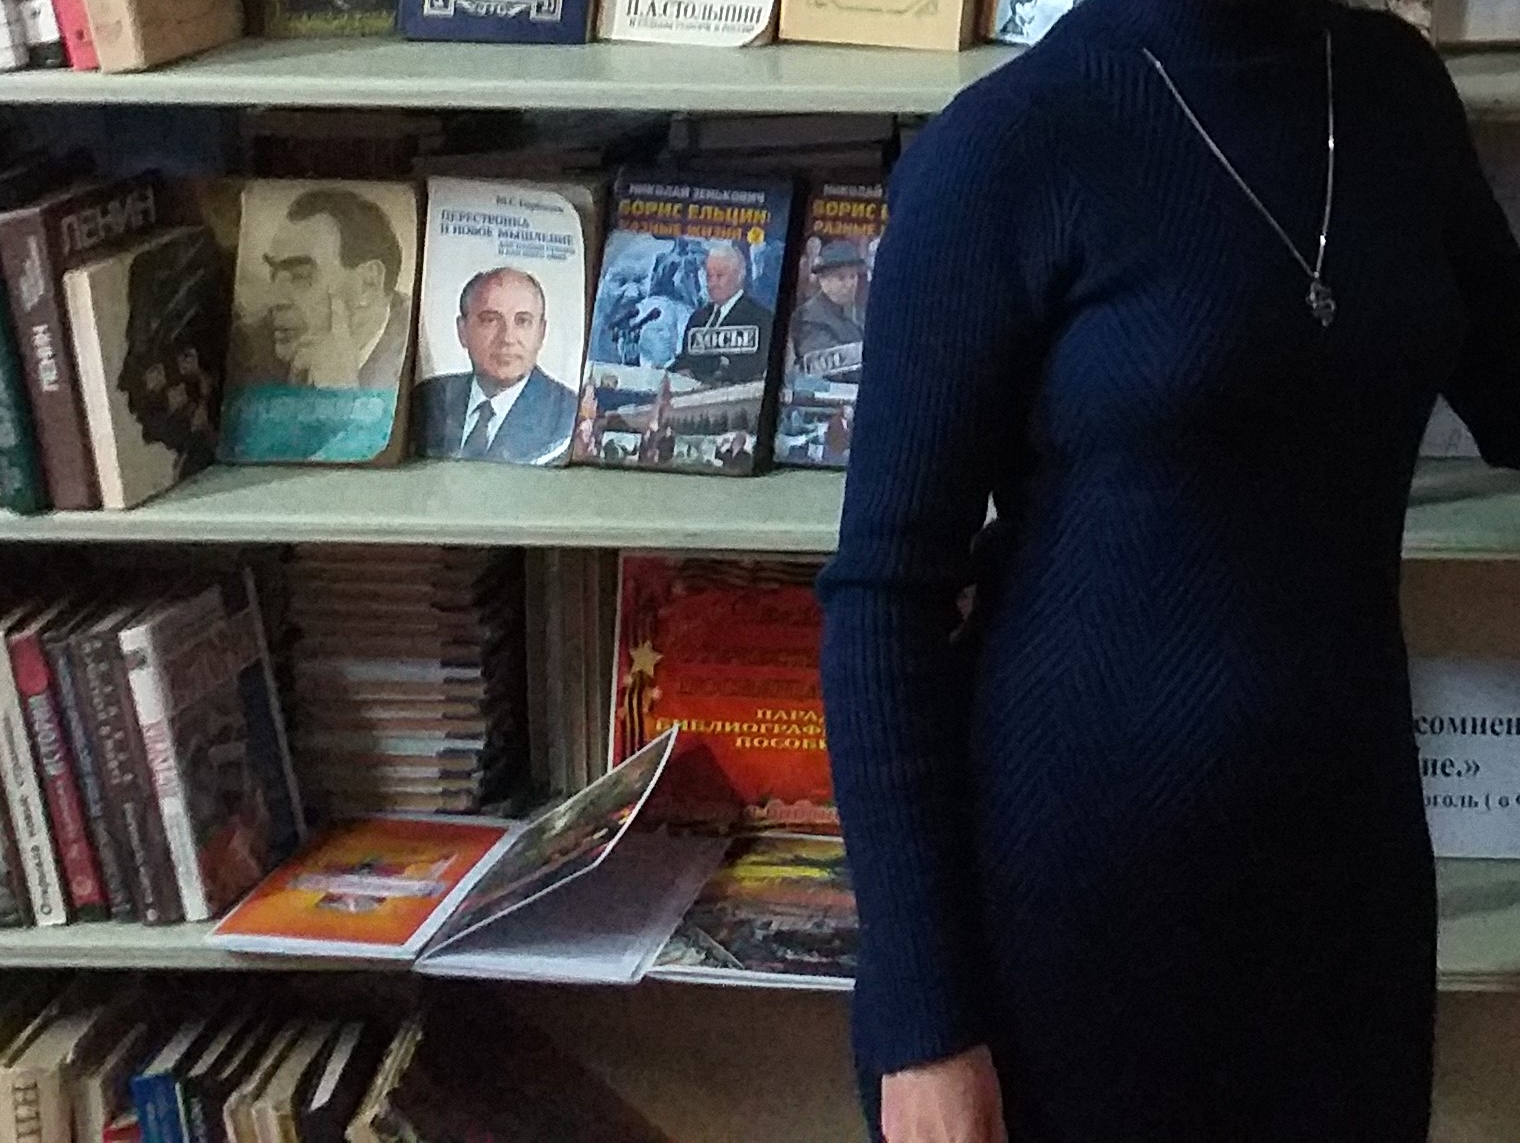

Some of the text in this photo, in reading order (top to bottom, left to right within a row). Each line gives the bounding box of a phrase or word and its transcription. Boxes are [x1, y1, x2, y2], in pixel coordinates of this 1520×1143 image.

[662, 0, 763, 25] СТОЛЫПИН
[629, 183, 767, 204] НИКОЛАЙ ЗЕНЬКОВИЧ
[618, 199, 683, 219] БОРИС
[813, 199, 877, 220] БОРИС
